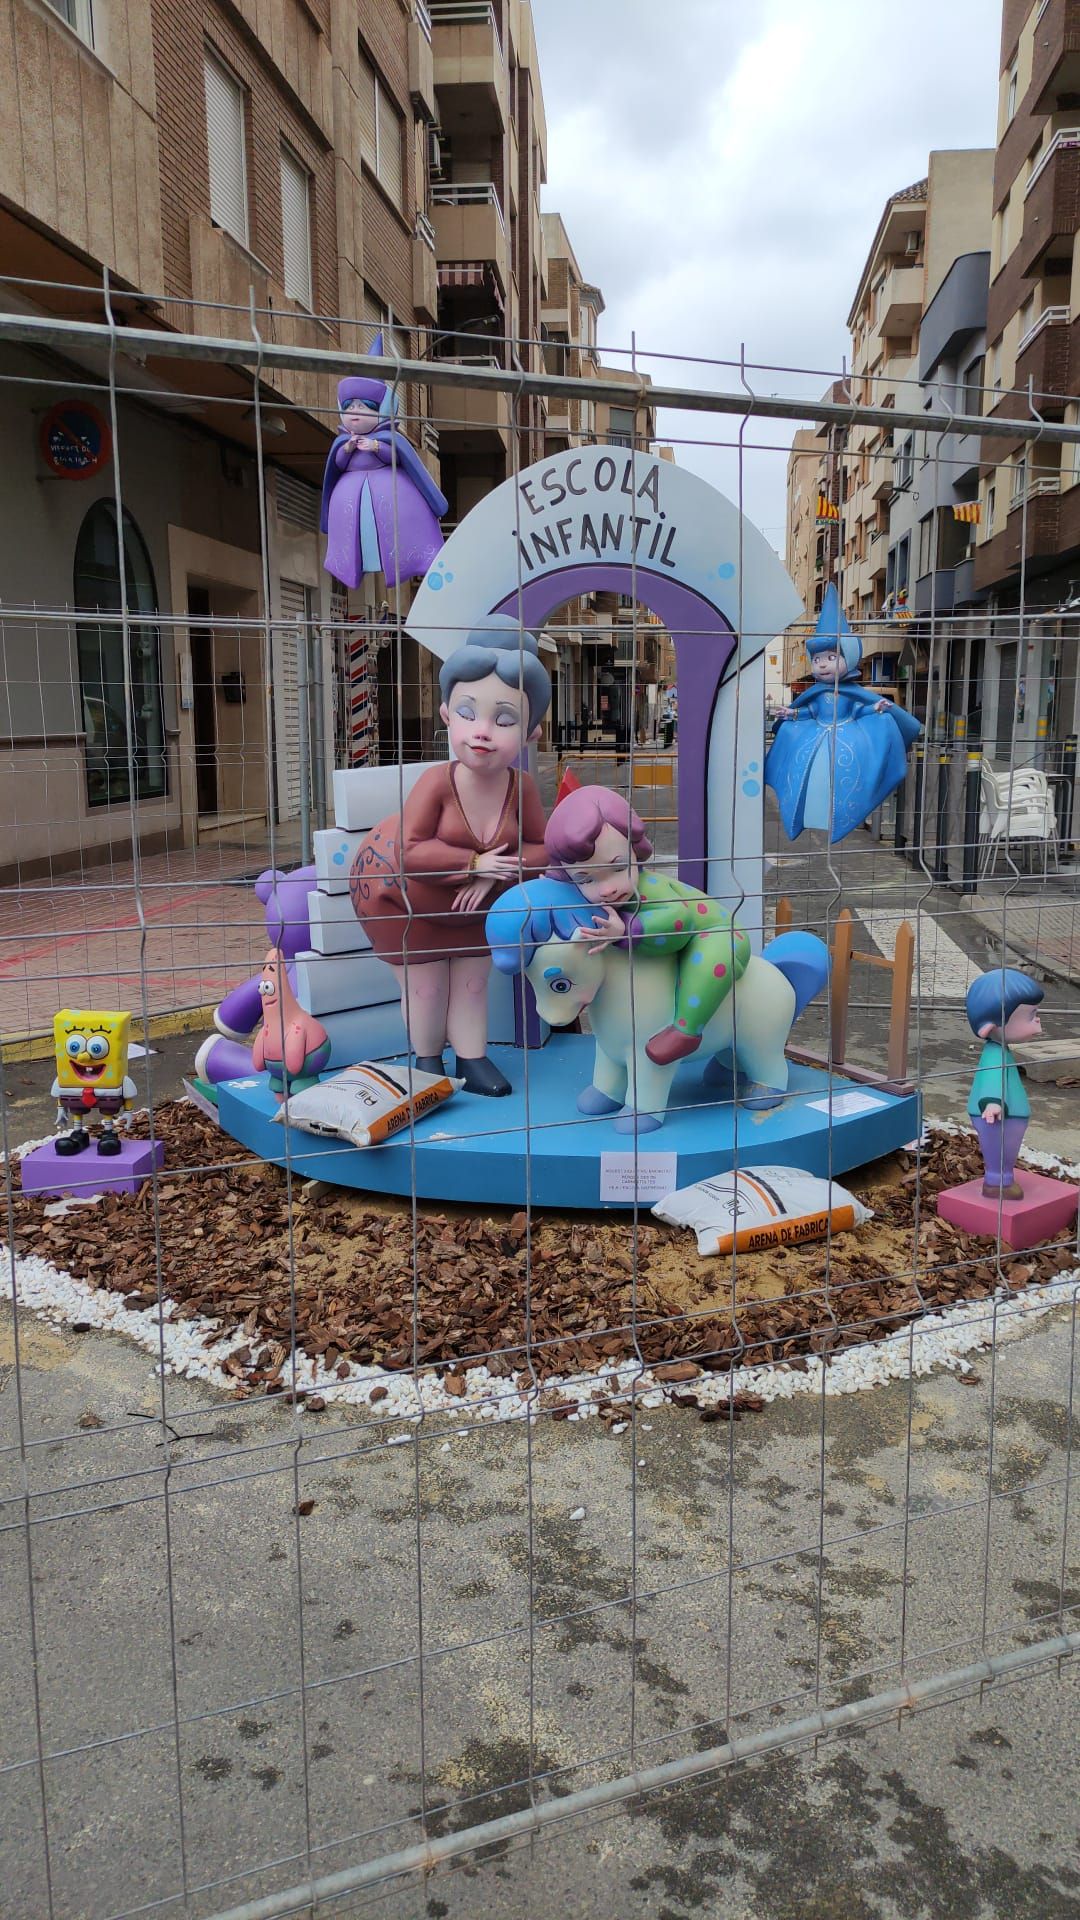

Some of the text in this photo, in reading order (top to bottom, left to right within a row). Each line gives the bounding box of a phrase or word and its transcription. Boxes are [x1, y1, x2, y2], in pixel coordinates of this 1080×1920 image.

[519, 456, 659, 516] ESCOLA
[511, 511, 677, 571] INFANTIL
[386, 1111, 406, 1132] ARENA
[415, 1091, 439, 1114] FABRICA
[749, 1217, 830, 1249] ARENA DE FABRICA
